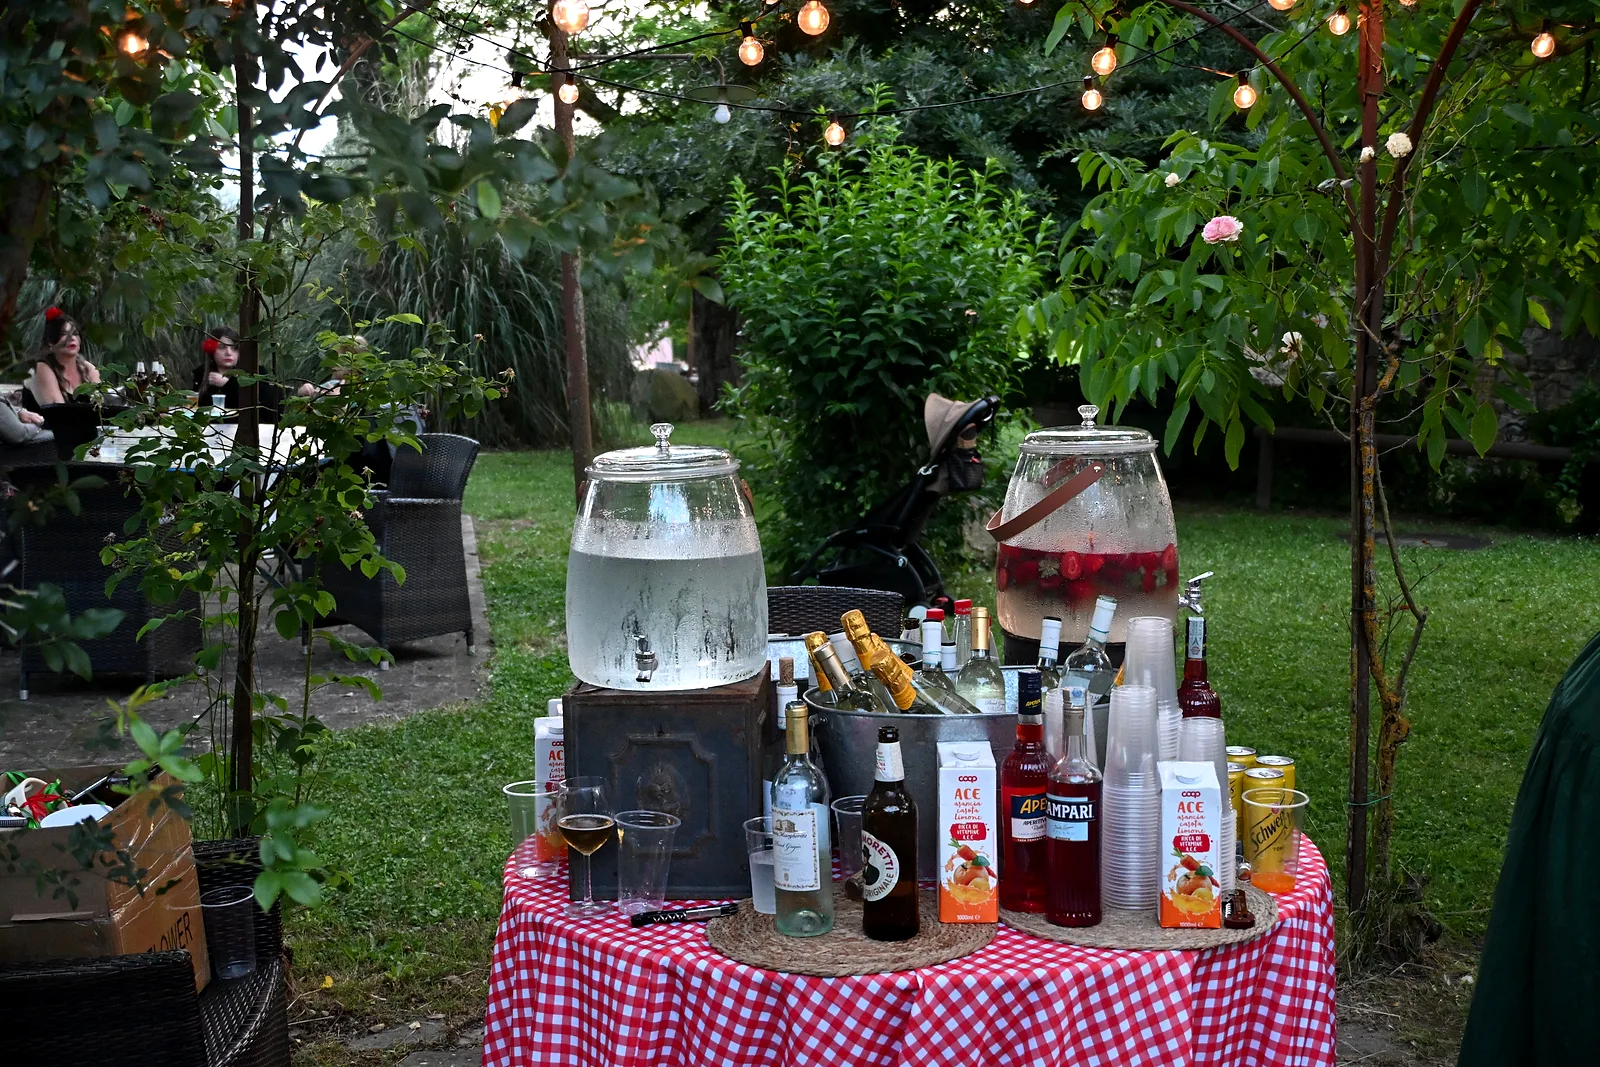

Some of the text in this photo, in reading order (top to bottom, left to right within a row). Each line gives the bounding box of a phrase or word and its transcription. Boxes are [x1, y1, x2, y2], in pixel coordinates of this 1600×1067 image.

[549, 750, 564, 761] AC
[954, 788, 981, 800] ACE
[1020, 797, 1046, 814] APE
[1046, 802, 1093, 819] AMPARI
[1177, 801, 1204, 813] ACE
[1023, 818, 1046, 826] APERITIV
